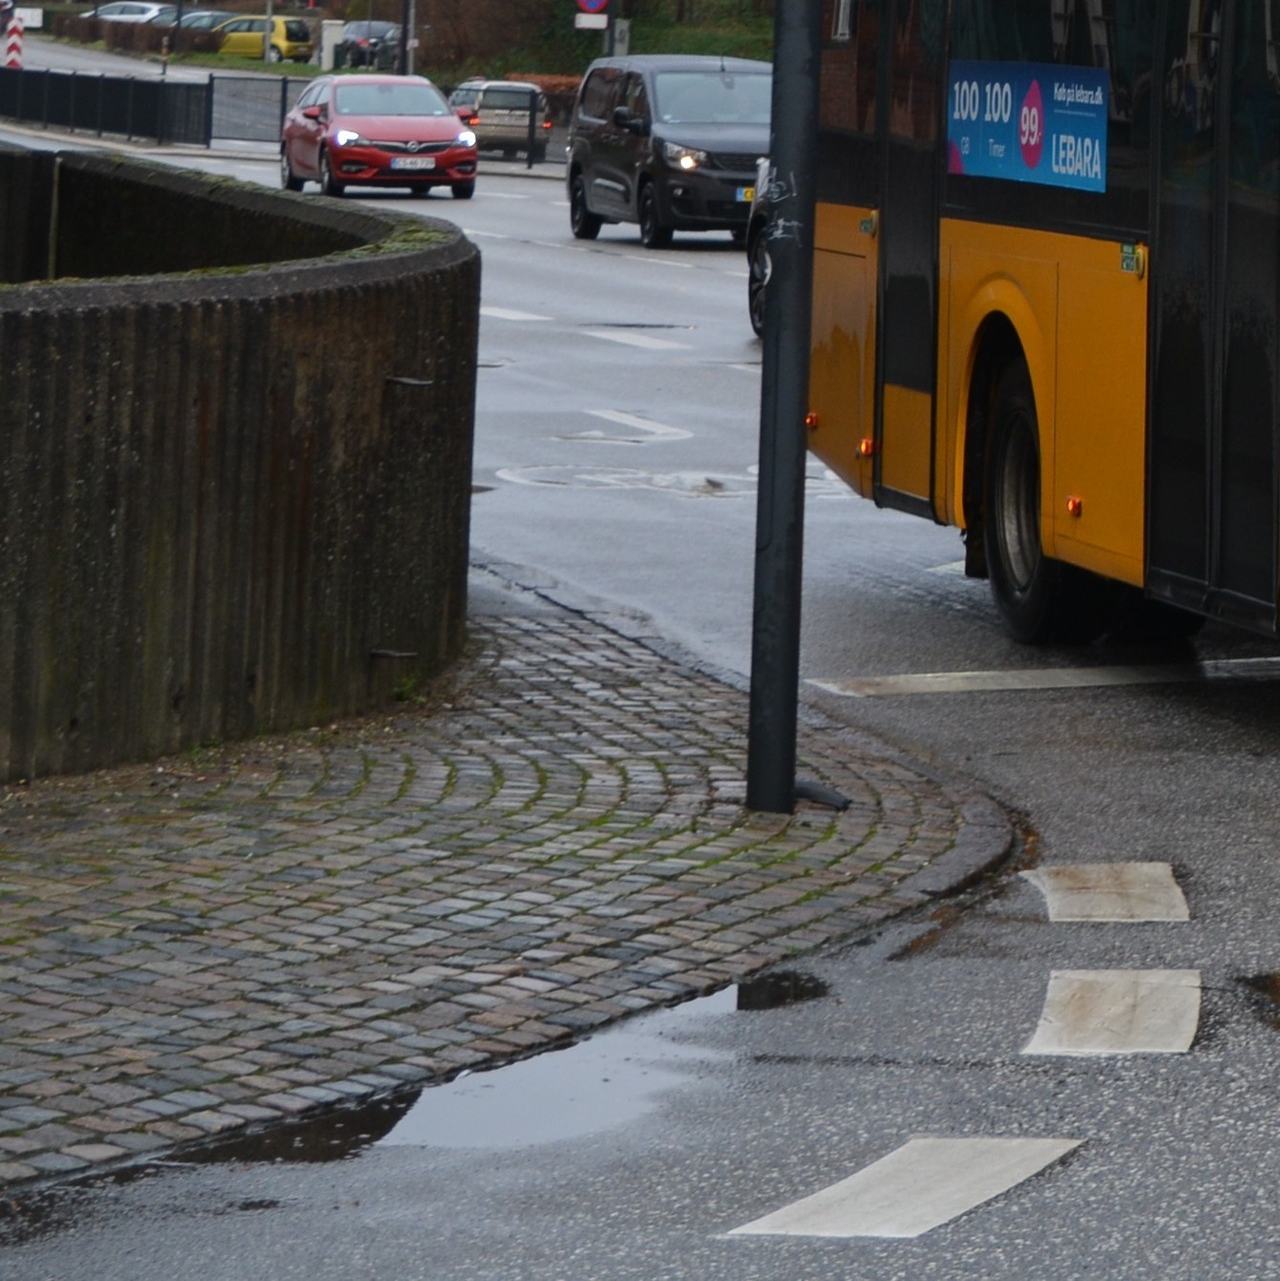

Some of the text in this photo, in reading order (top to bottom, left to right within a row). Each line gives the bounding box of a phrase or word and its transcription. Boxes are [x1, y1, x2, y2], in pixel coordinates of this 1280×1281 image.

[954, 81, 1012, 123] 100 100
[1052, 134, 1101, 179] LEBARA
